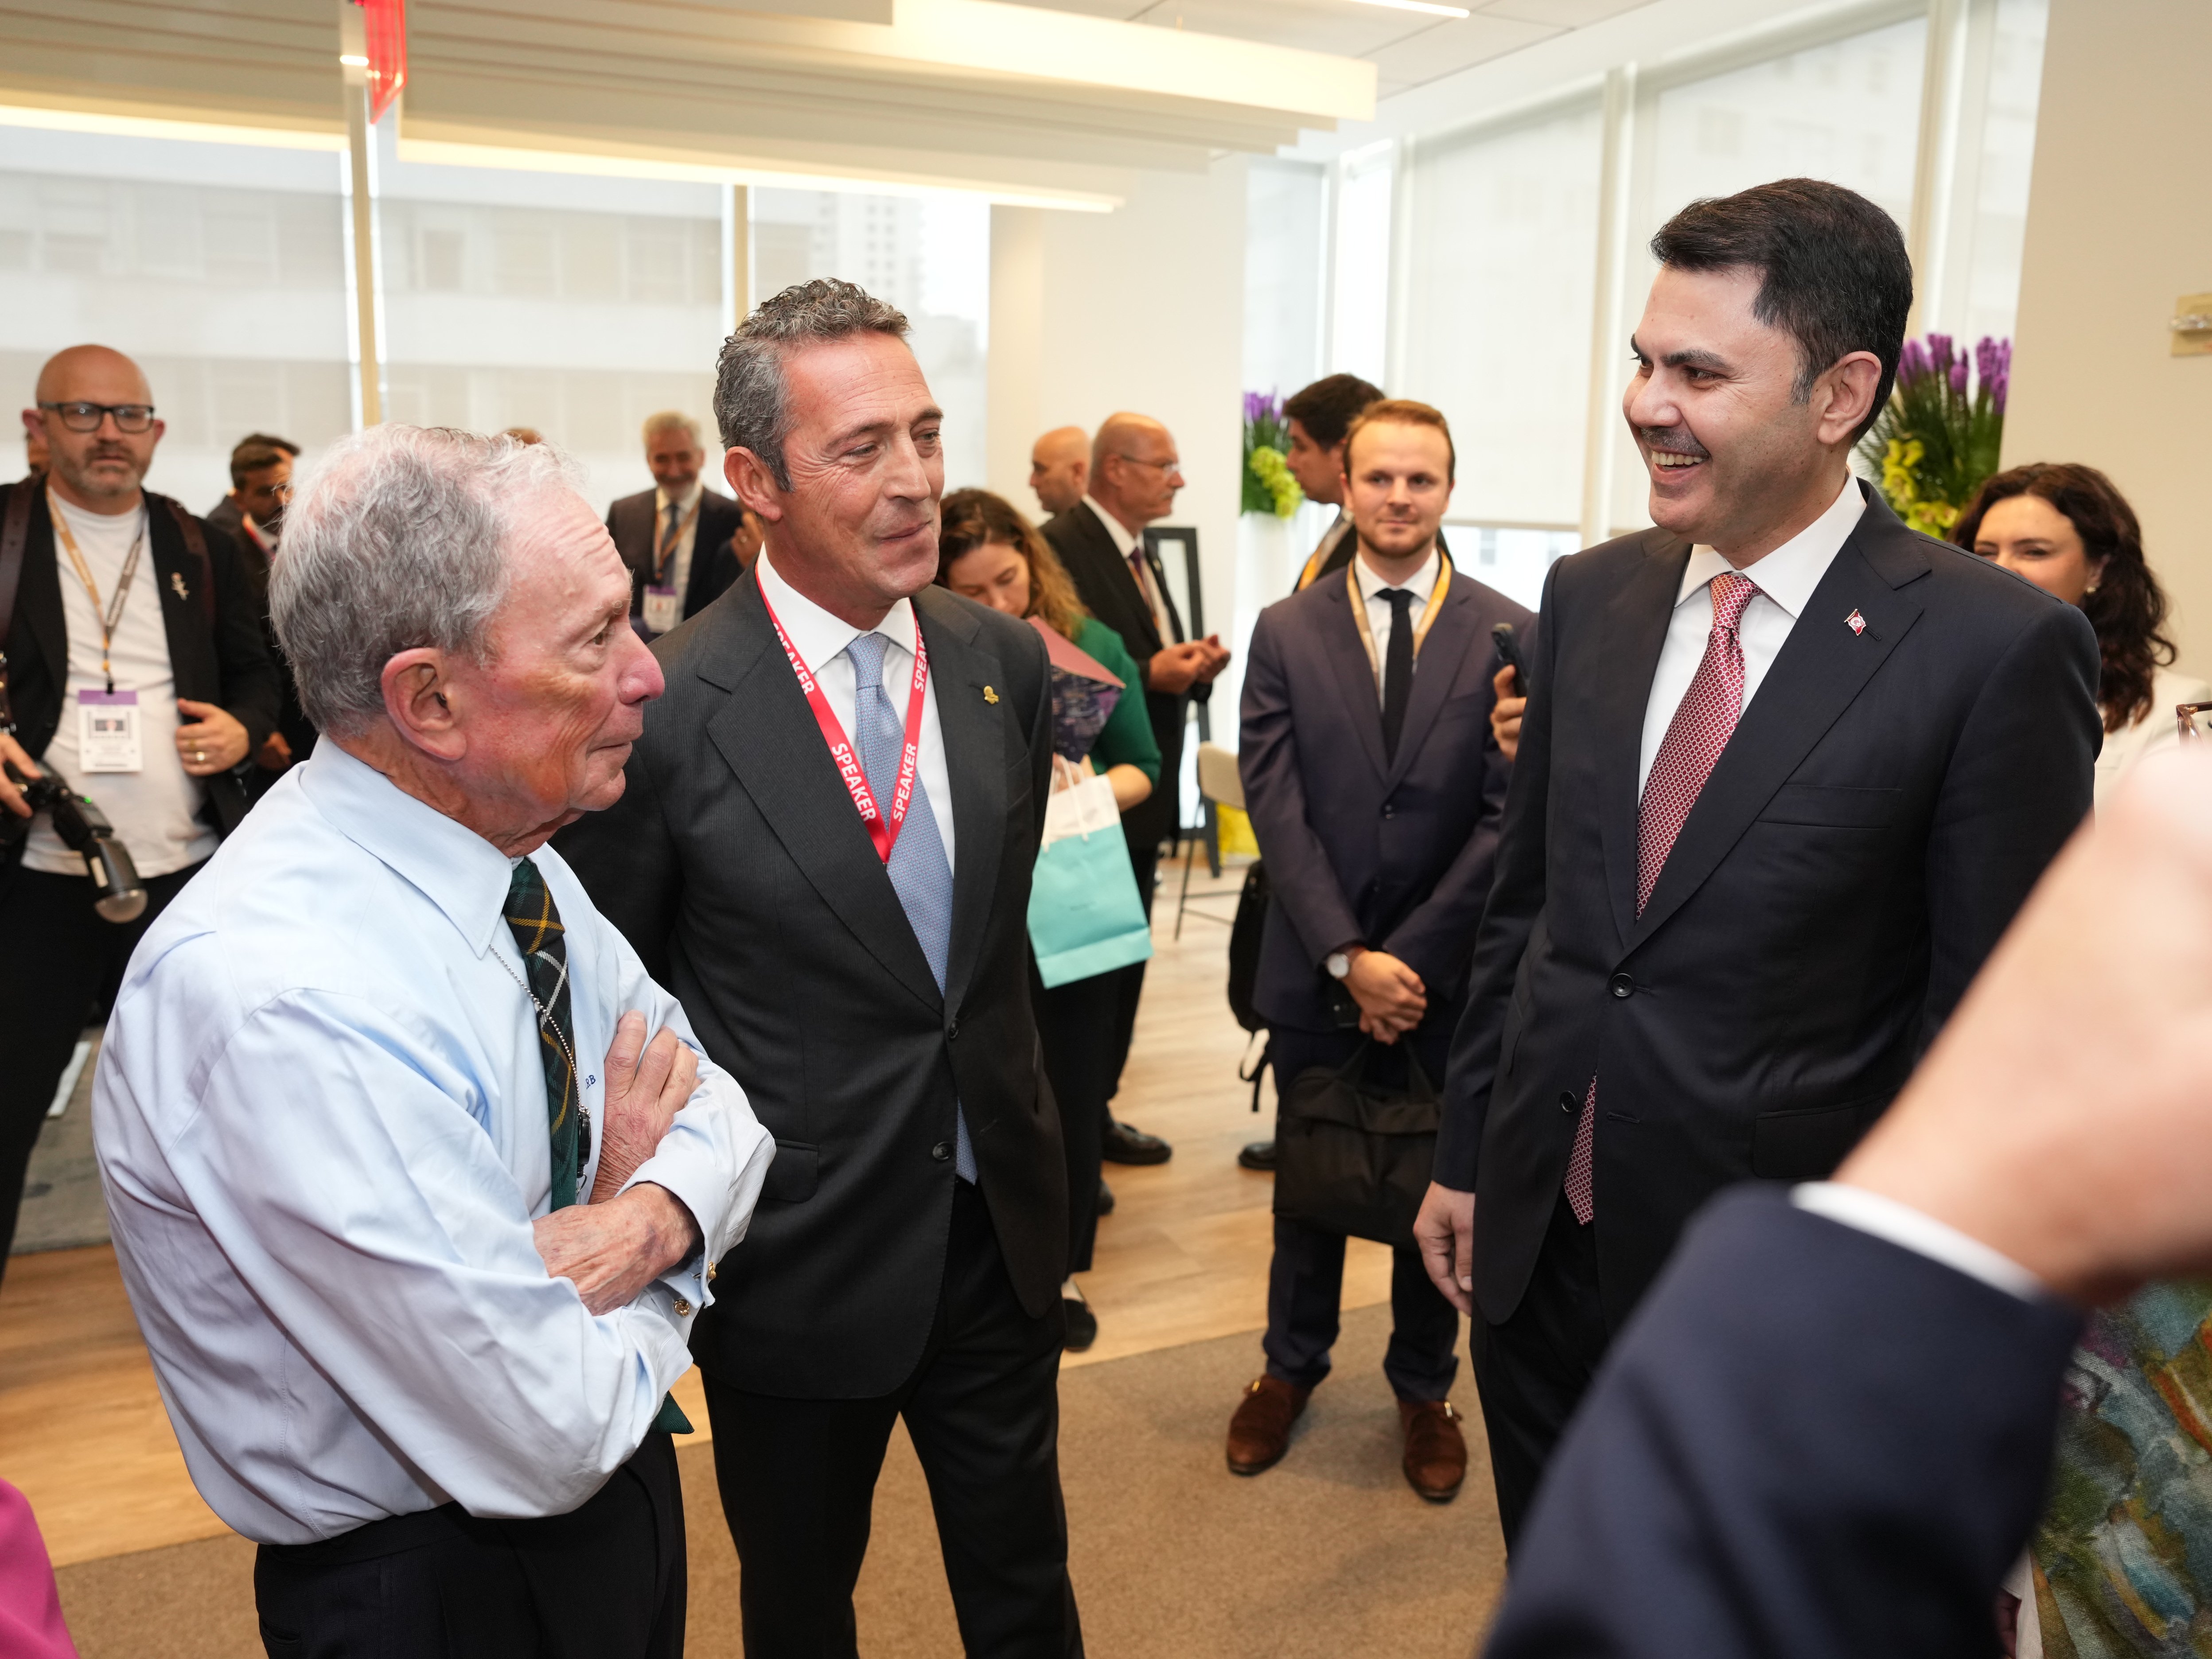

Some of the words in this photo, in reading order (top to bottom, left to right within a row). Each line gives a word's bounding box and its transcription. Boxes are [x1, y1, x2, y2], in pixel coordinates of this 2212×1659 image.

[832, 743, 876, 822] SPEAKER
[893, 743, 916, 822] SPEAKER
[914, 620, 927, 693] SPEAK
